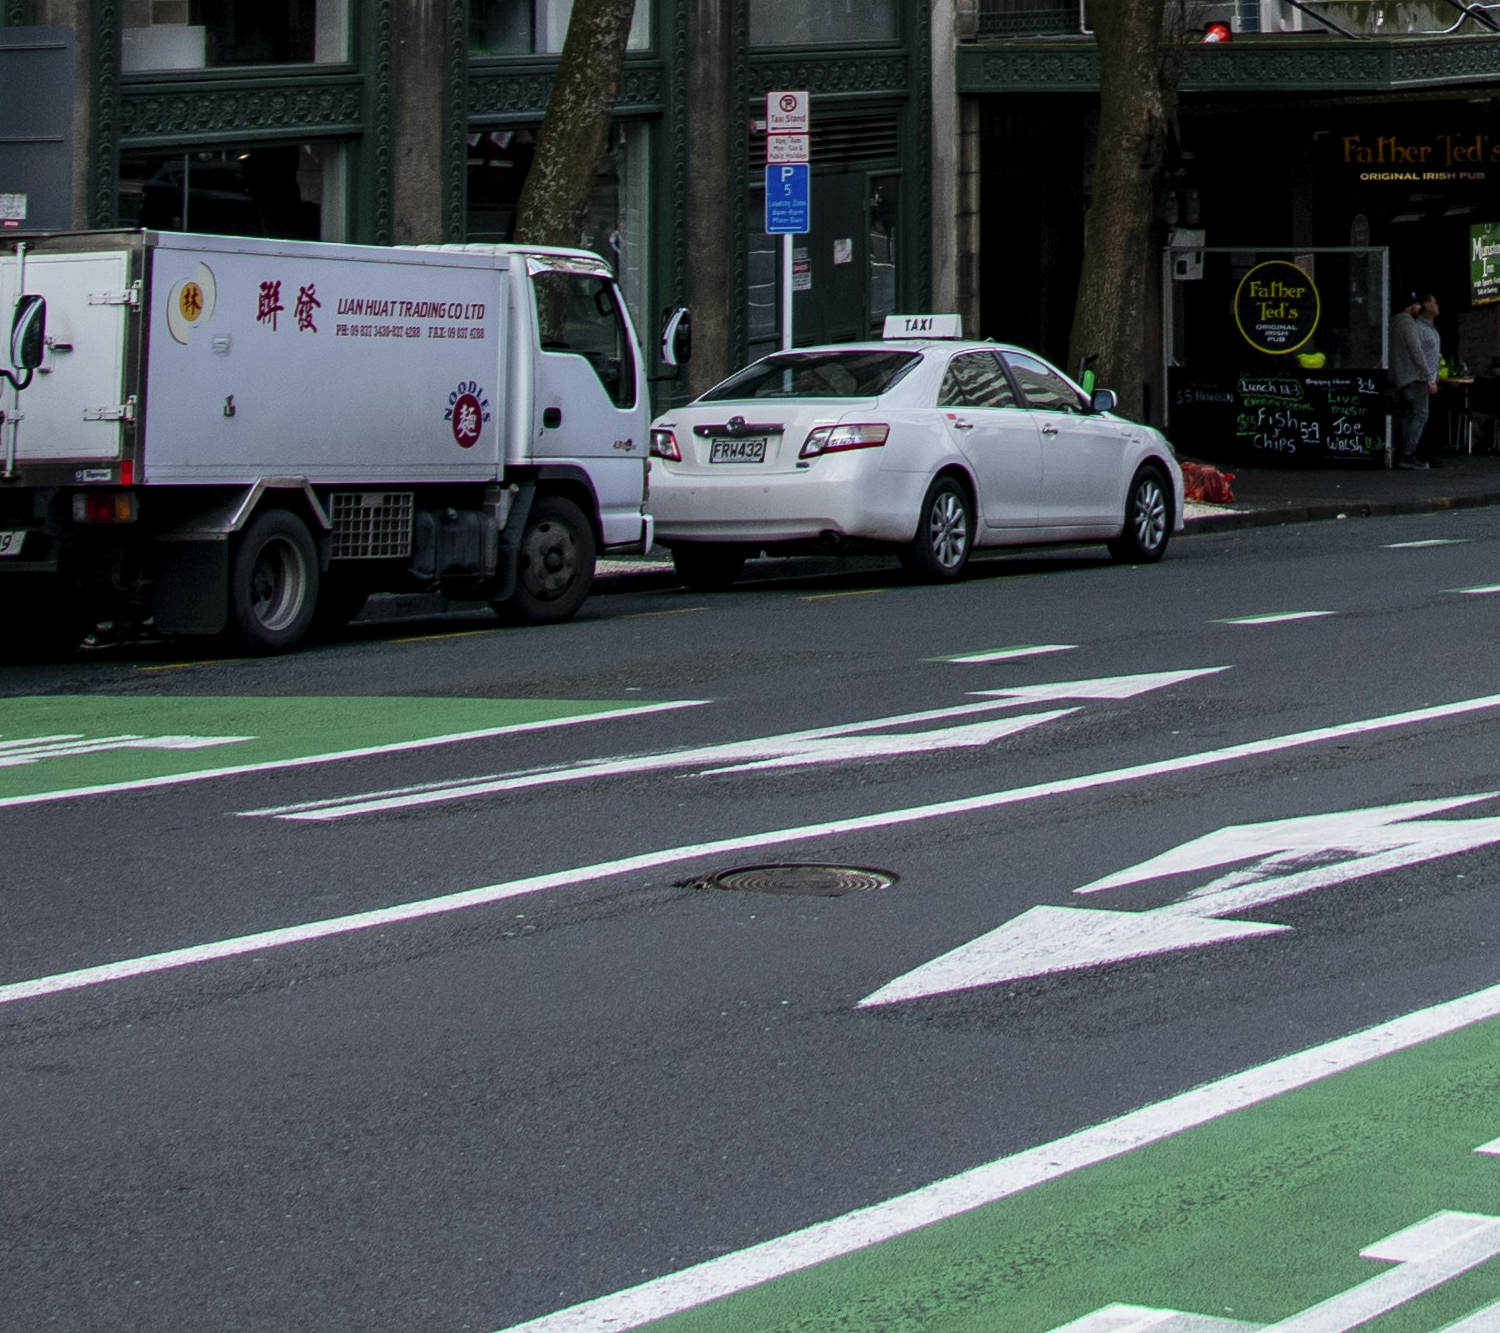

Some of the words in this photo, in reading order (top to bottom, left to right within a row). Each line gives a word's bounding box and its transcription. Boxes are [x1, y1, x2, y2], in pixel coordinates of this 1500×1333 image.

[1342, 135, 1433, 165] Father
[781, 167, 794, 182] P
[1360, 171, 1420, 182] ORIGINAL
[1422, 171, 1457, 181] IRISH
[1459, 171, 1486, 181] PUB
[784, 184, 791, 196] 5
[1250, 281, 1305, 299] Father
[183, 287, 203, 316] 林
[337, 298, 364, 315] LIAN
[365, 299, 398, 317] HUAT
[399, 301, 447, 319] TRADING
[448, 302, 463, 319] CO
[464, 303, 486, 320] LTD
[1256, 301, 1300, 321] Ted's
[905, 318, 934, 332] TAXI
[1242, 380, 1277, 396] Lunch
[444, 381, 491, 423] NOODLES
[1328, 393, 1360, 404] Live
[1257, 406, 1299, 430] Fish
[1333, 416, 1364, 435] Joe
[713, 439, 763, 459] FRW432
[1253, 434, 1297, 454] Chips
